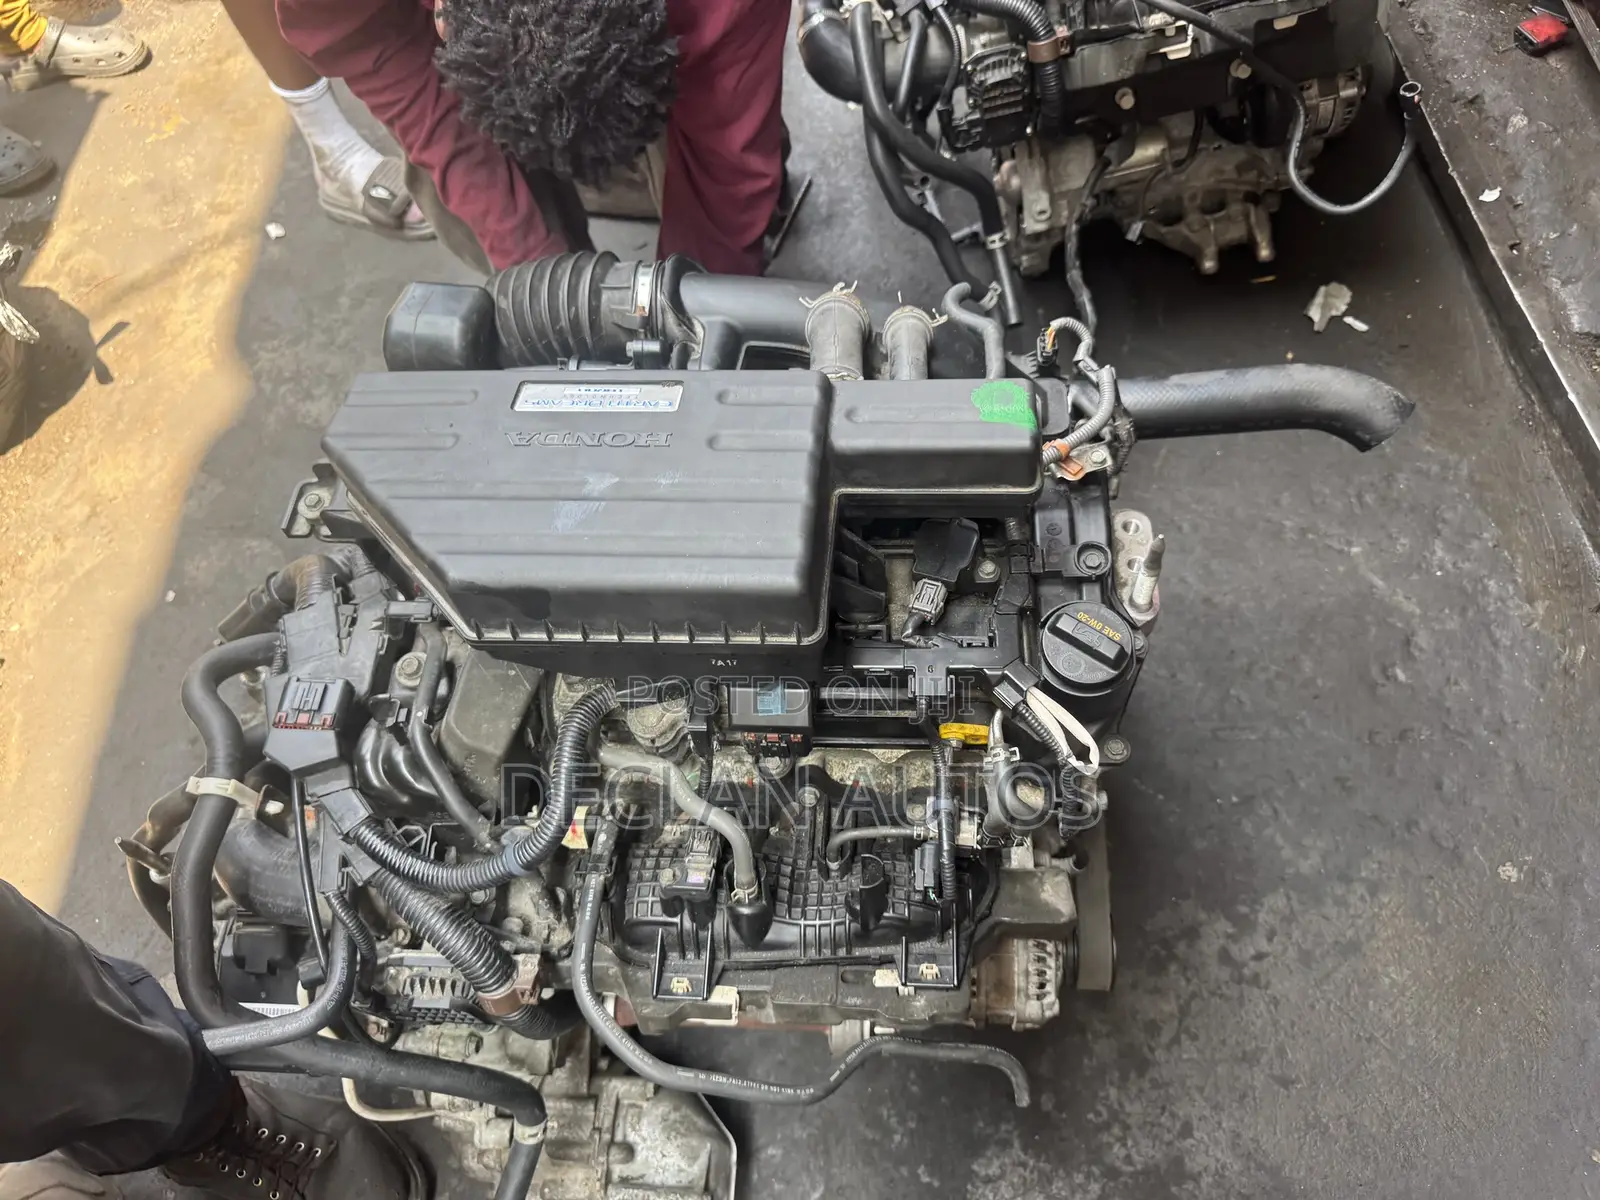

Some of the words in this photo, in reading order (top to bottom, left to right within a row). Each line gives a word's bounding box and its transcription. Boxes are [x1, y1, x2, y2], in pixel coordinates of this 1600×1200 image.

[505, 431, 674, 448] HONDA
[1077, 611, 1103, 630] 0W-20
[1103, 625, 1122, 641] SAE
